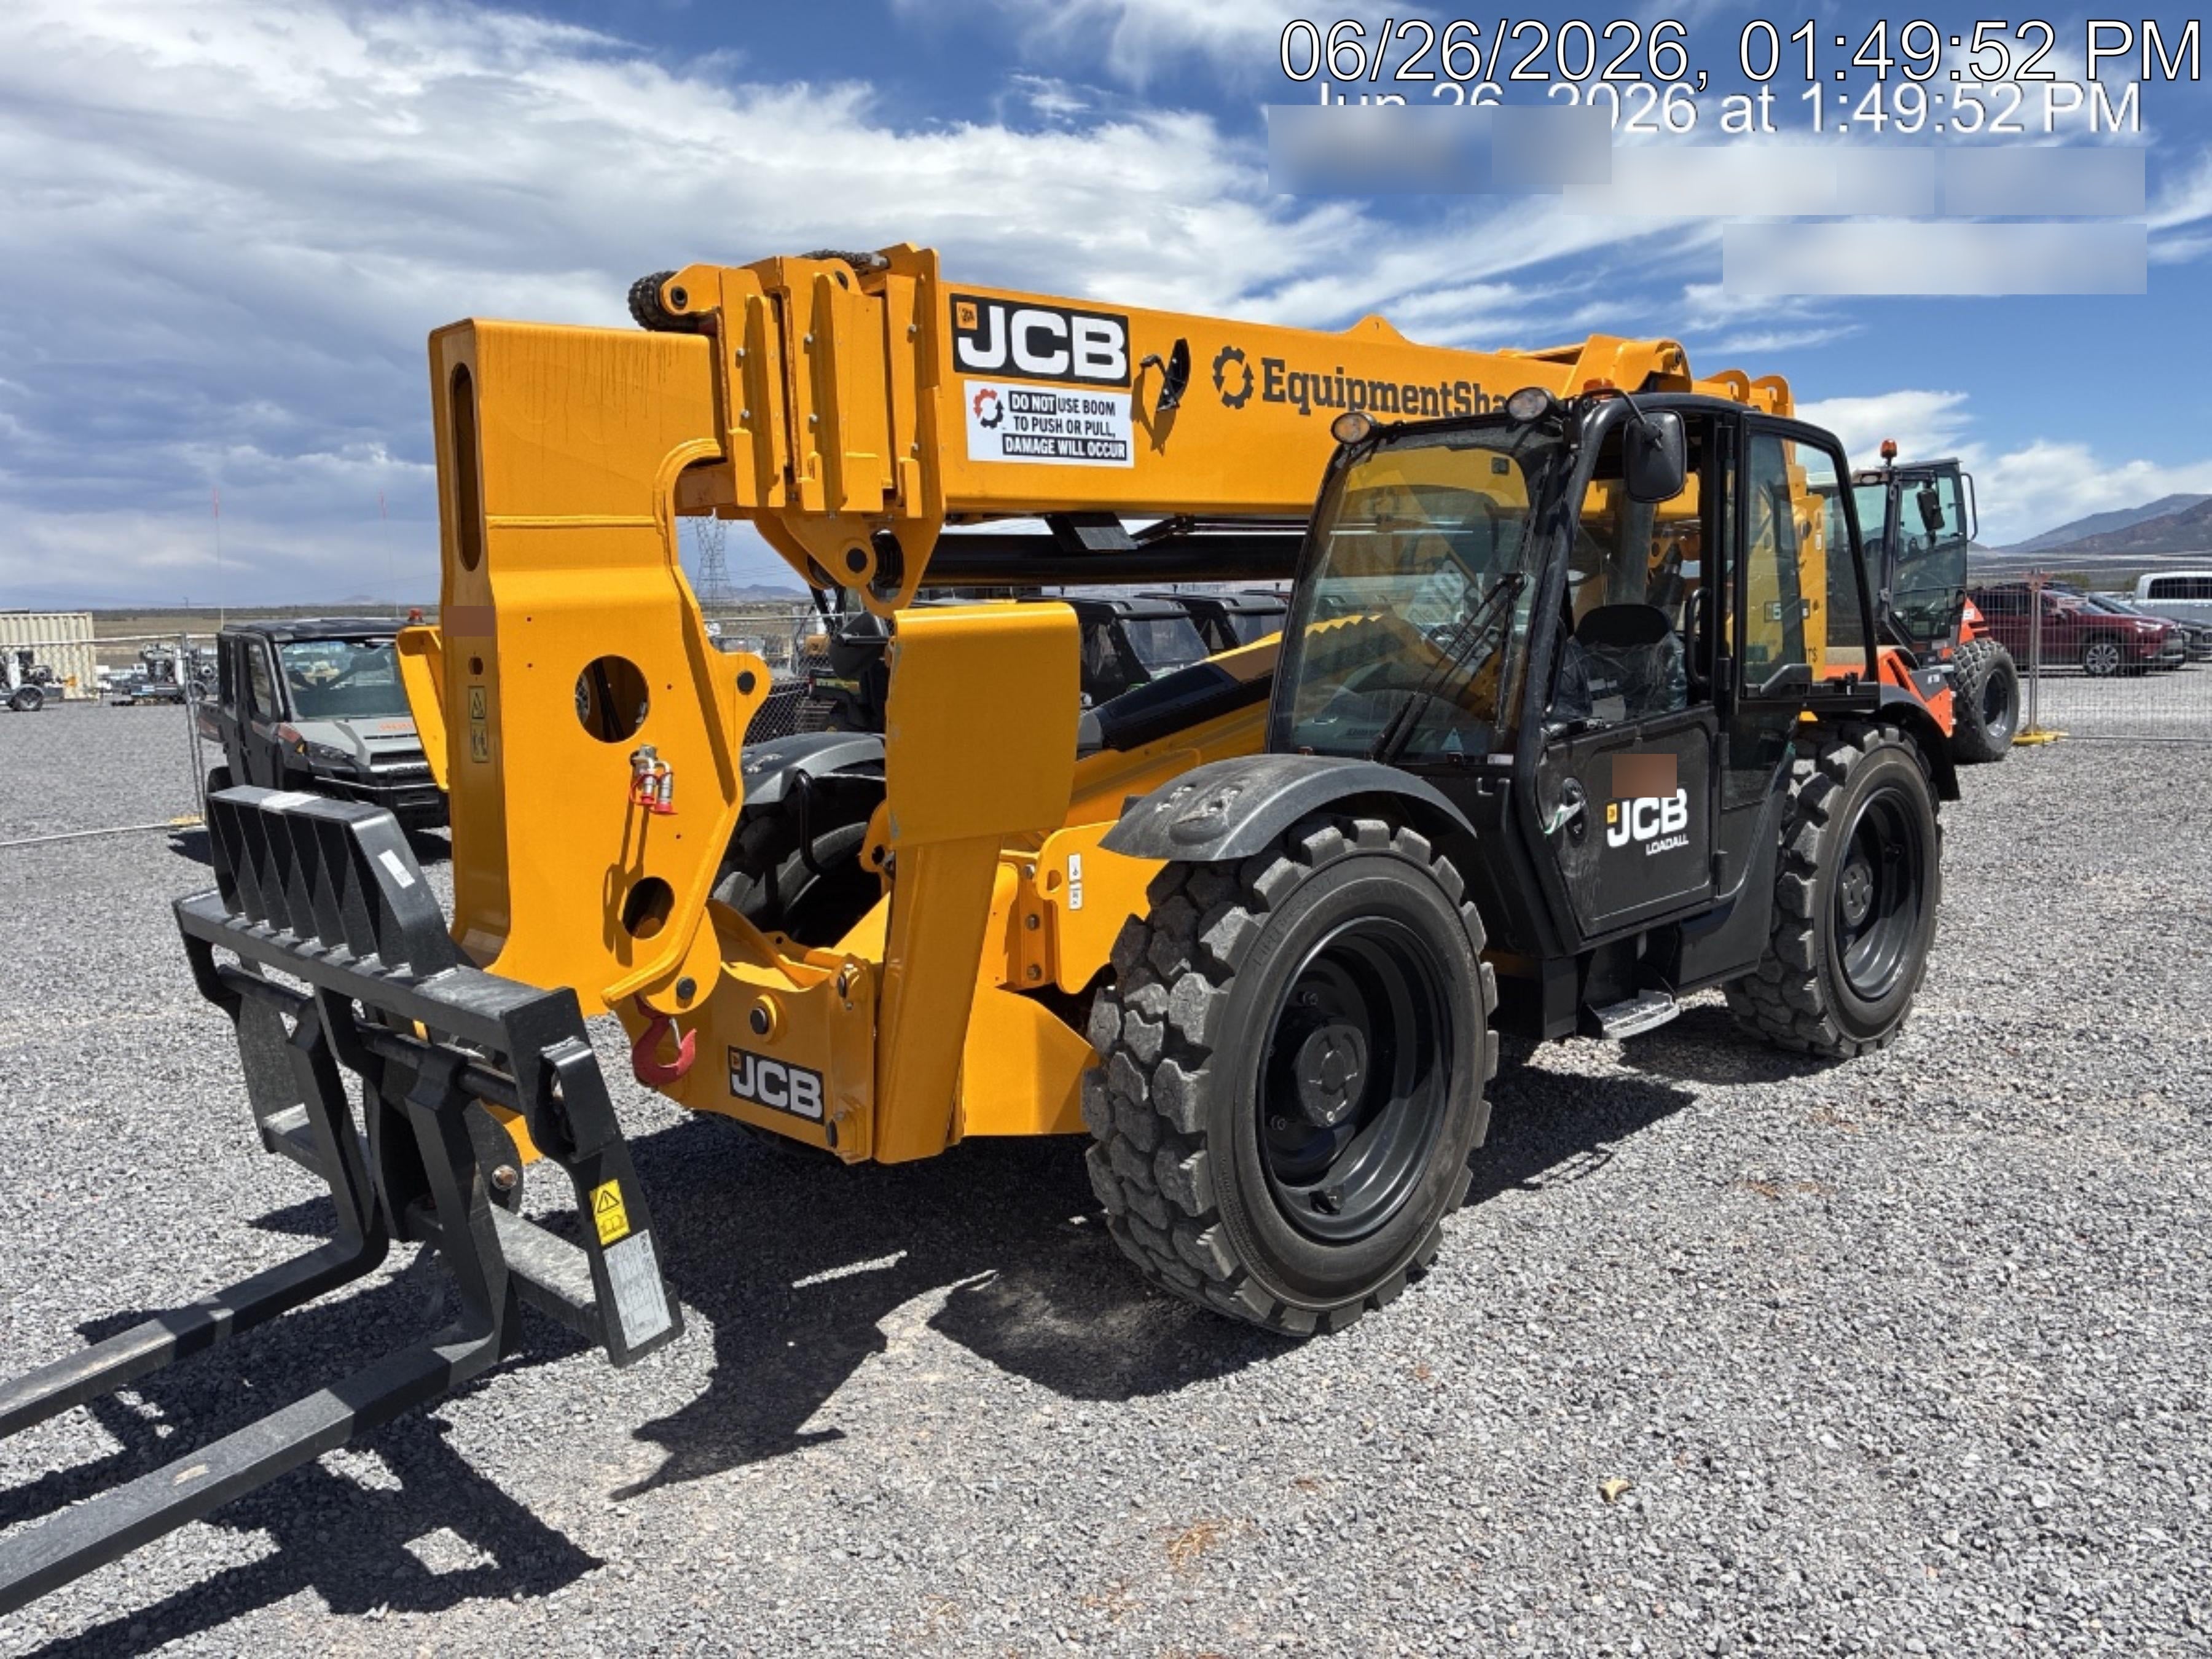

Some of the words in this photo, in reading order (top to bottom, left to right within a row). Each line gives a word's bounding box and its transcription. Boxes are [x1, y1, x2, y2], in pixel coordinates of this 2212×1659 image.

[957, 305, 1127, 379] JCB
[1011, 393, 1027, 410] DO
[1032, 395, 1056, 413] NOT
[1058, 398, 1080, 414] USE
[1083, 399, 1116, 417] BOOM
[1261, 357, 1507, 417] EquipmentSha
[1005, 437, 1056, 454] DAMAGE
[1057, 440, 1086, 457] WILL
[1087, 442, 1126, 458] OCCUR
[1014, 416, 1029, 432] TO
[1032, 417, 1063, 434] PUSH
[1066, 420, 1083, 436] OR
[1085, 420, 1116, 438] PULL,
[1607, 788, 1688, 848] JCB
[1645, 833, 1689, 856] LOADALL
[731, 1055, 822, 1118] JCB
